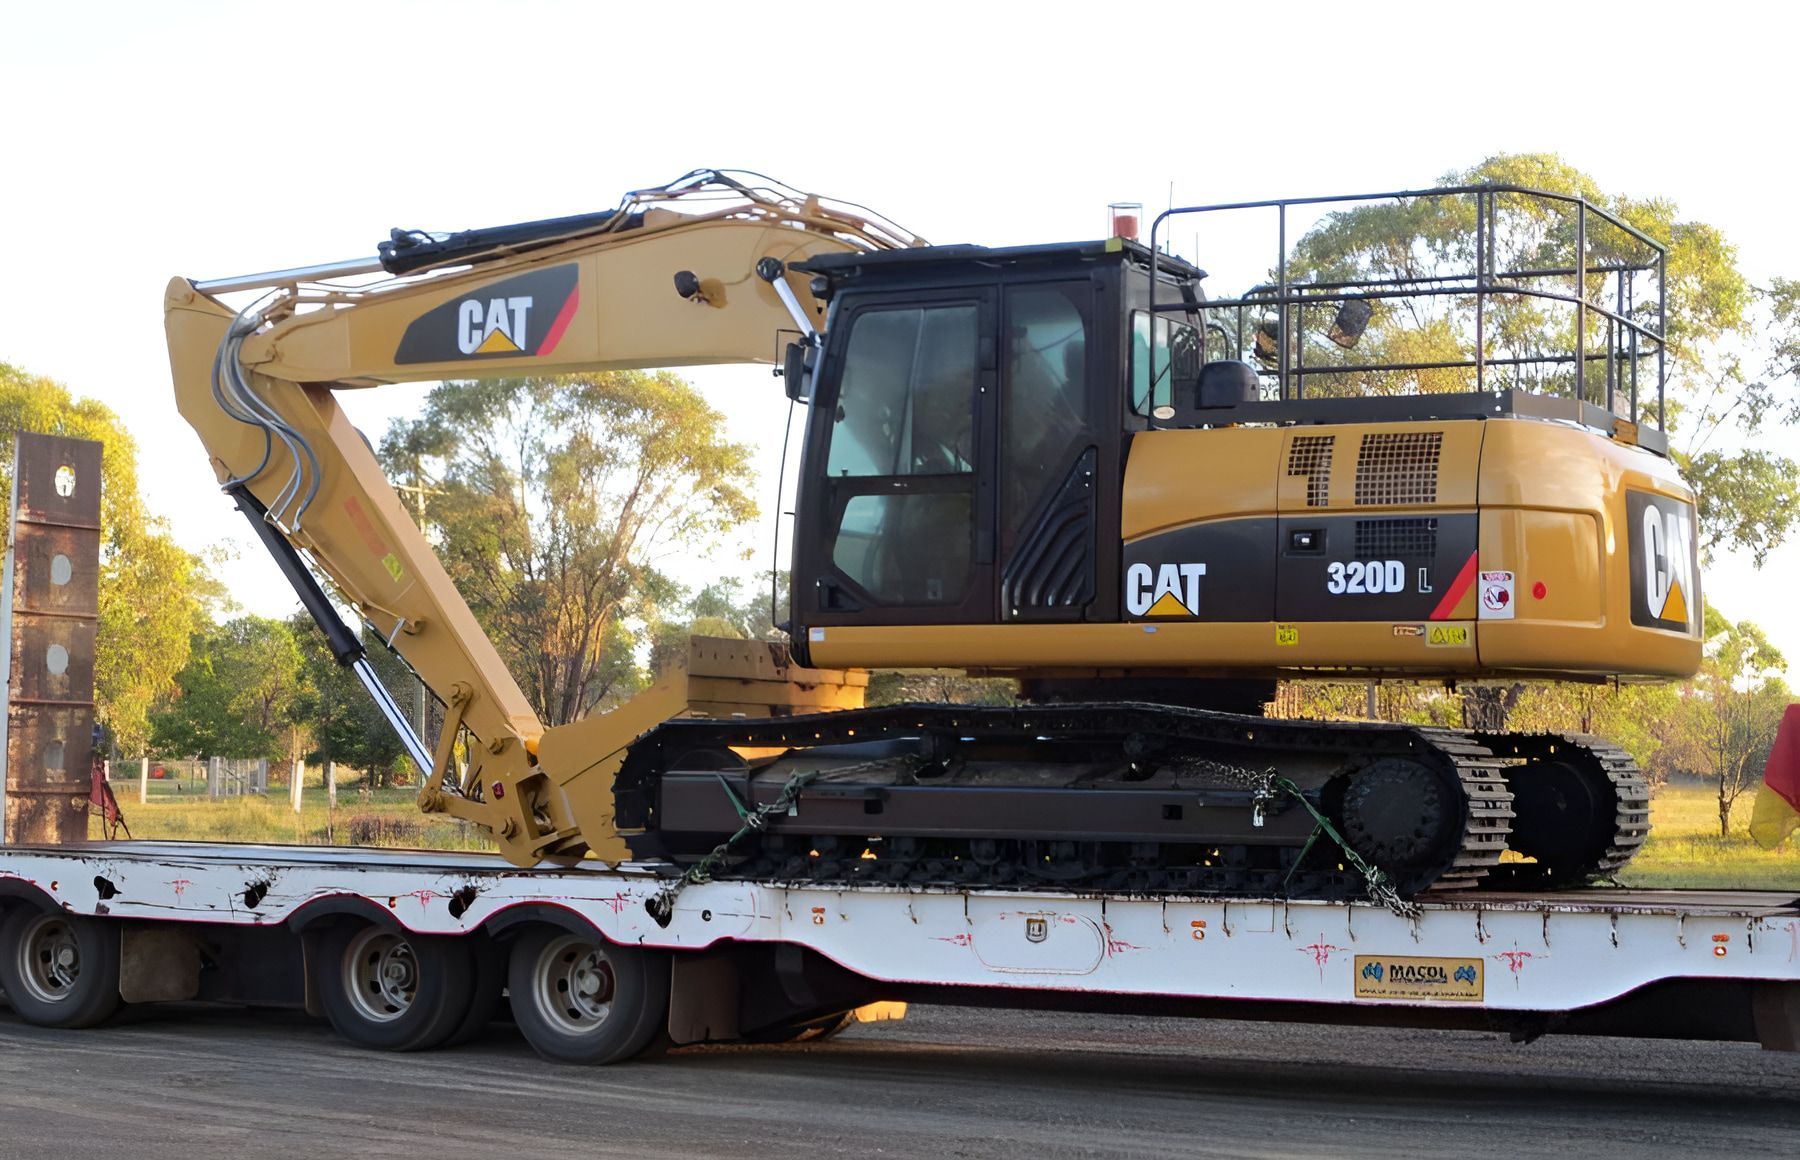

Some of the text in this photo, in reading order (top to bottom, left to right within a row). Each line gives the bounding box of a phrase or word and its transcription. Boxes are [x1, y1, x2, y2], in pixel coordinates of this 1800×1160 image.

[458, 296, 533, 354] CAT
[1127, 563, 1206, 616] CAT
[1327, 561, 1432, 594] 320D L
[1644, 504, 1694, 625] CAT
